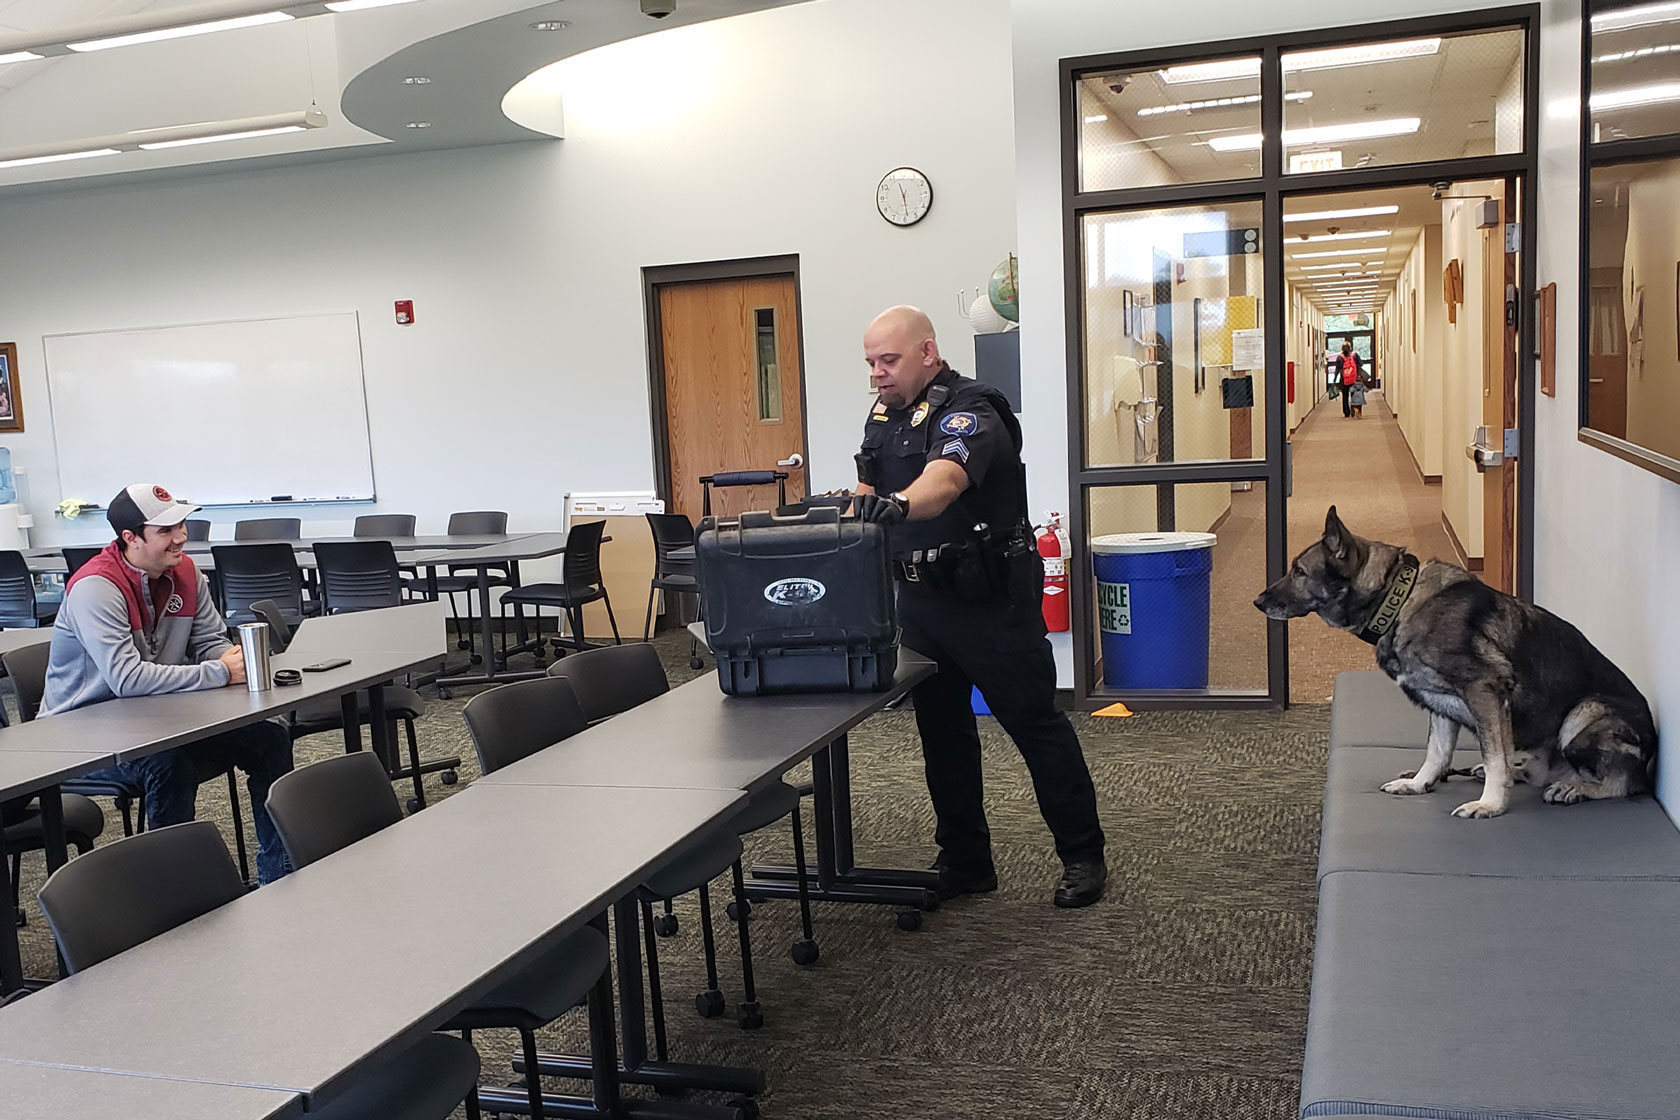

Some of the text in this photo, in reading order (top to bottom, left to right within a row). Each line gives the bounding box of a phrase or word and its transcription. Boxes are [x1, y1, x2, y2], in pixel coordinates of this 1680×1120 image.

[1299, 158, 1334, 172] EXIT
[1098, 584, 1128, 607] CYCLE
[1371, 566, 1414, 633] POLICE K-9
[1100, 608, 1118, 631] ERE
